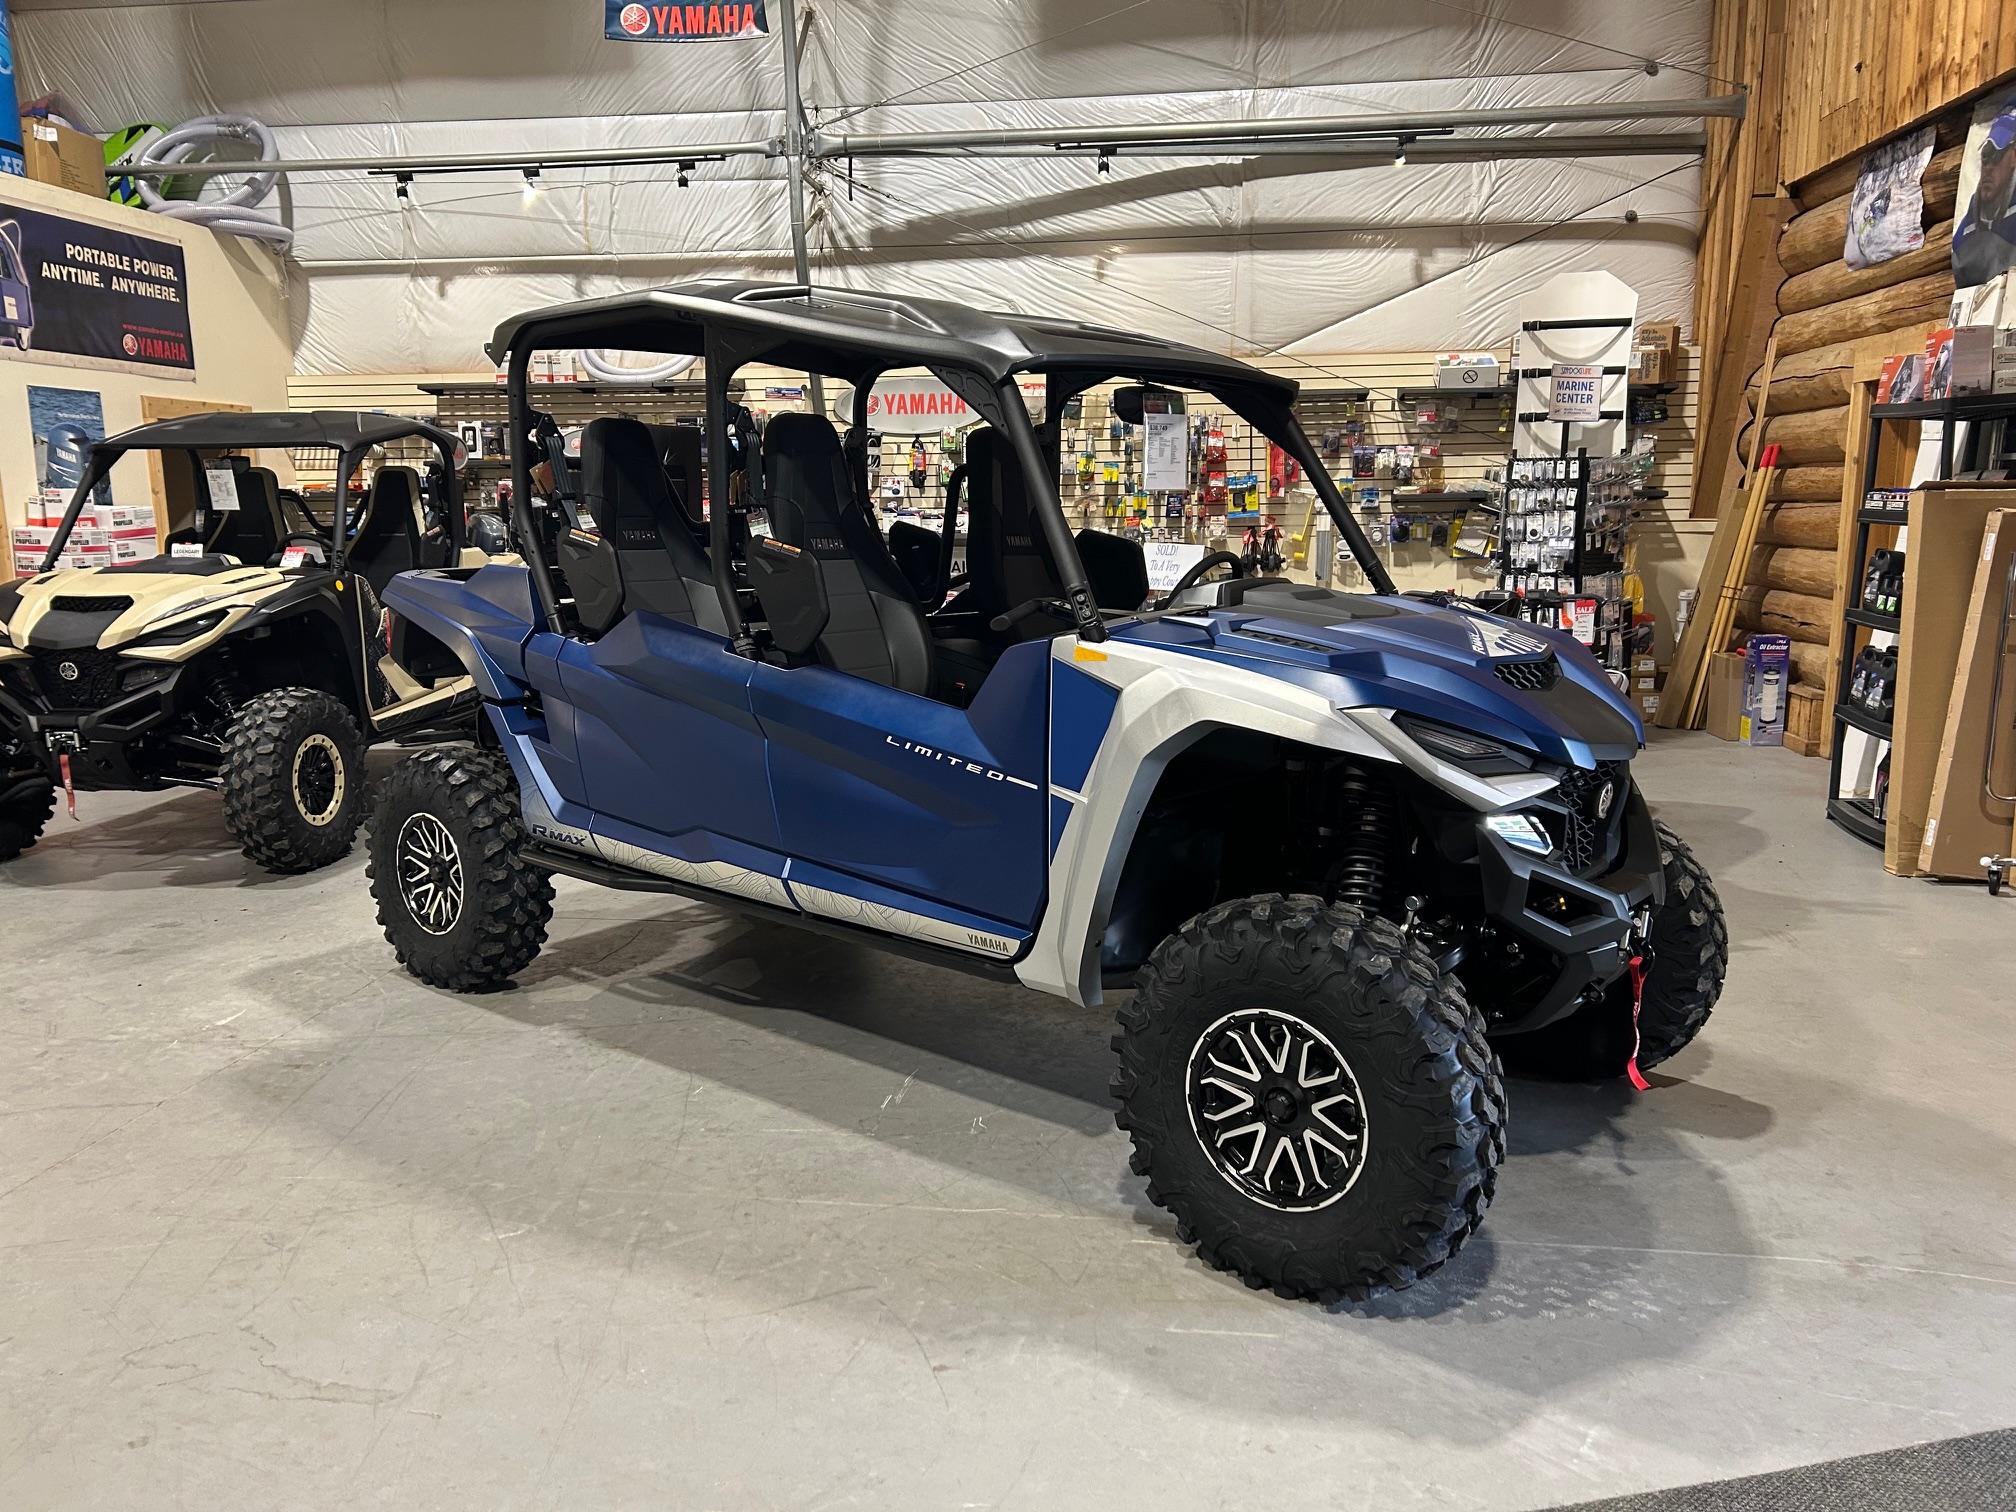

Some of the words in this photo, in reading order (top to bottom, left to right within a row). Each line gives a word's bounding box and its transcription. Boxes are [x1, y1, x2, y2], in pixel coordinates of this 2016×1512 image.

[652, 4, 754, 34] YAMAHA
[65, 243, 131, 271] PORTABLE
[134, 258, 178, 281] POWER.
[41, 261, 104, 288] ANYTIME.
[111, 276, 180, 302] ANYWHERE.
[137, 336, 187, 361] YAMAHA
[1556, 381, 1594, 391] MARINE
[883, 393, 967, 415] YAMAHA
[1556, 393, 1593, 404] CENTER
[622, 530, 656, 540] YAMAHA
[1006, 535, 1032, 546] YAMAHA
[810, 538, 845, 550] YAMAHA
[1156, 545, 1179, 556] SOLD!
[1150, 560, 1158, 571] To
[1158, 560, 1165, 571] A
[1166, 561, 1180, 574] Very
[886, 735, 1004, 781] LIMITED
[967, 933, 1009, 953] YAMAHA
